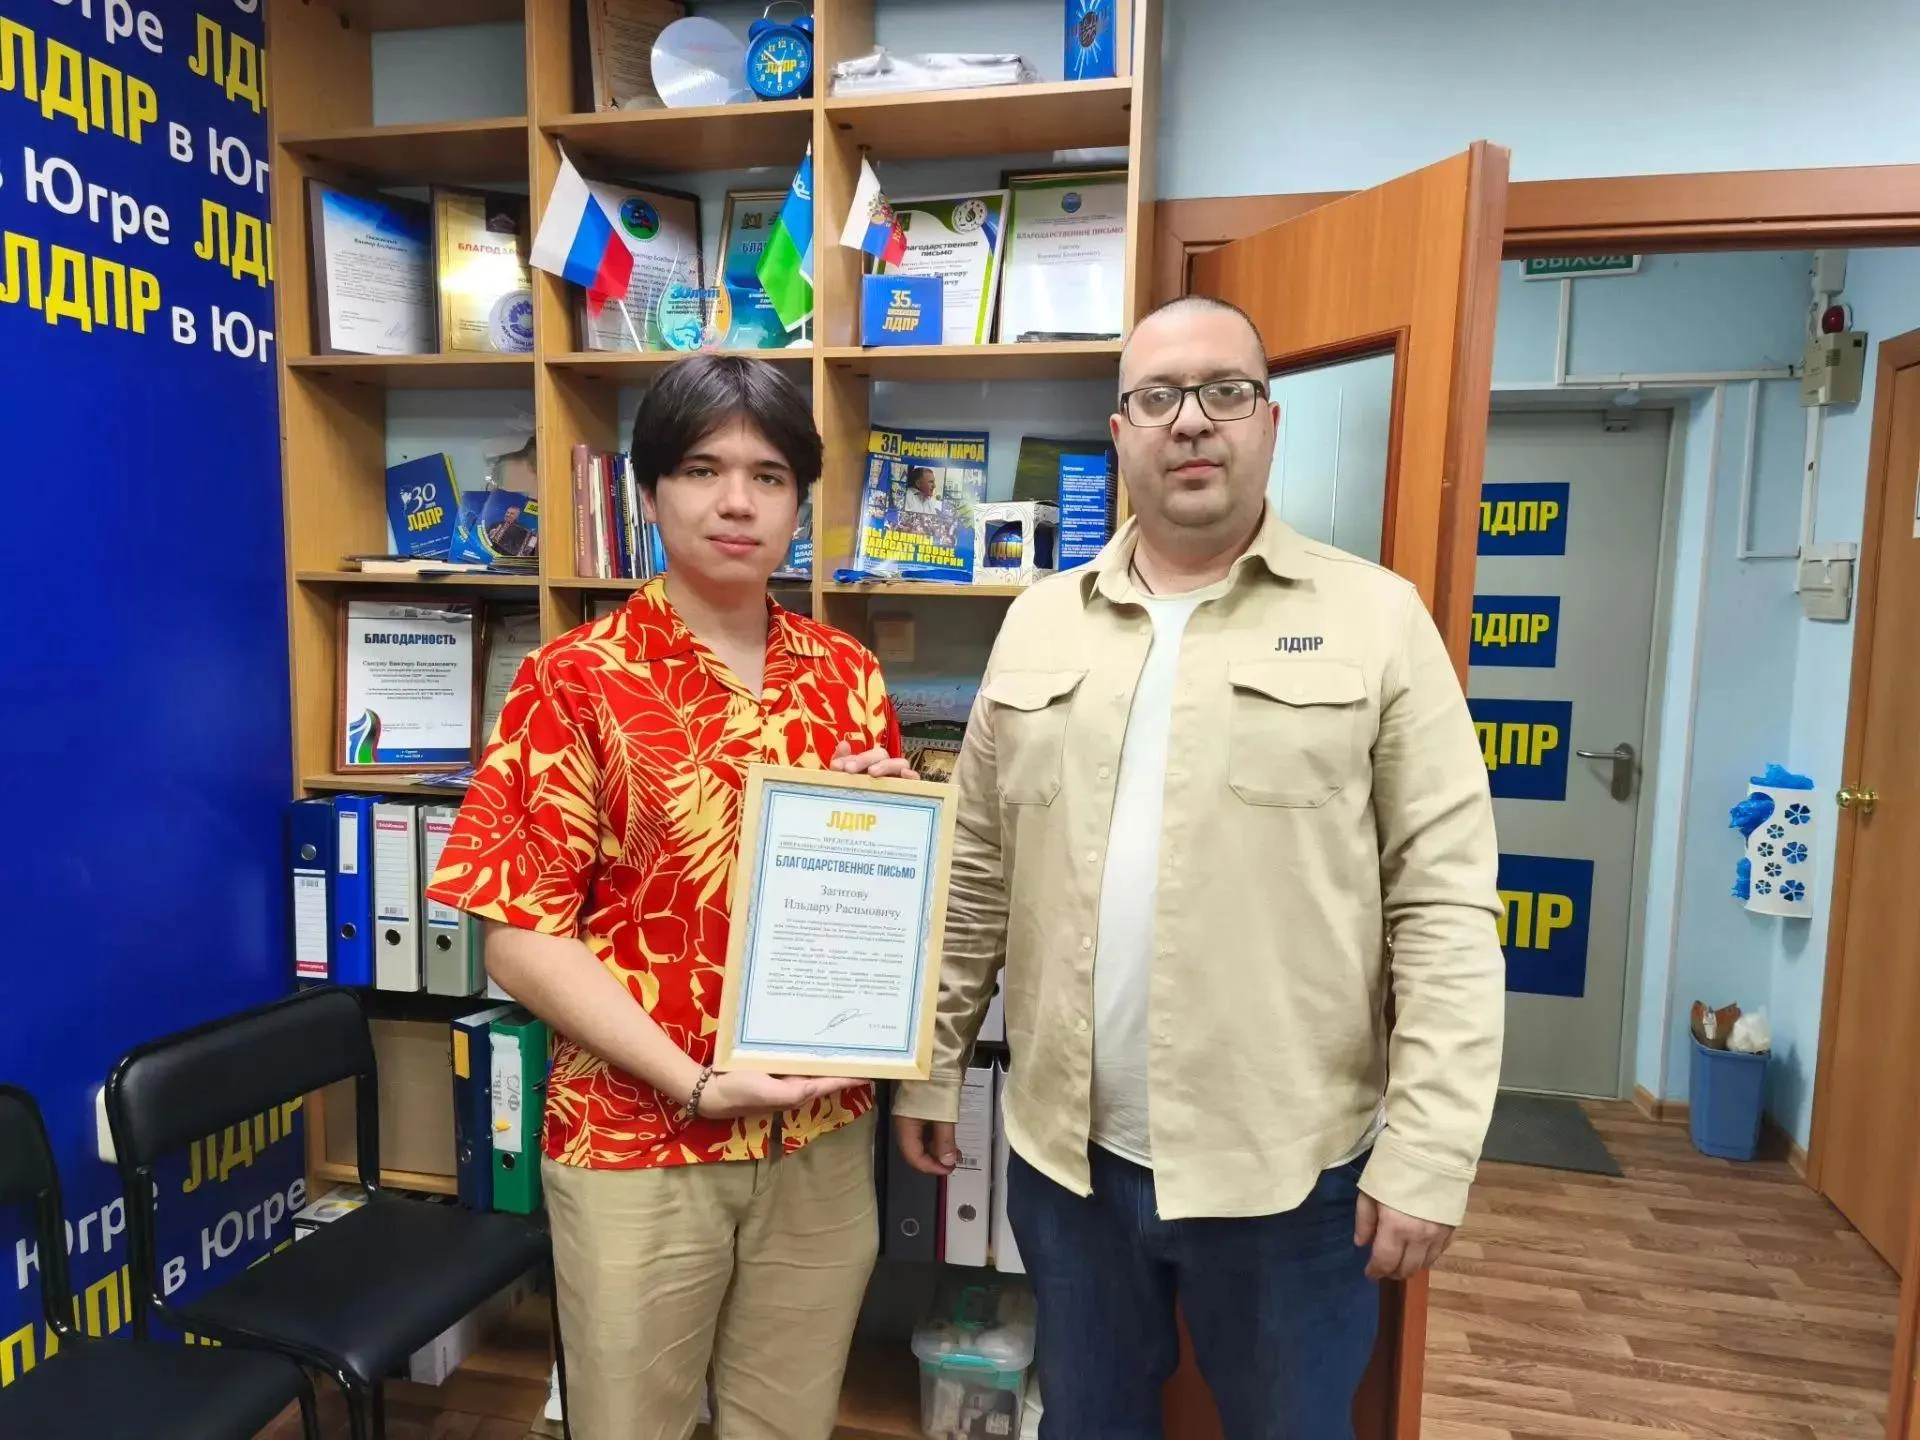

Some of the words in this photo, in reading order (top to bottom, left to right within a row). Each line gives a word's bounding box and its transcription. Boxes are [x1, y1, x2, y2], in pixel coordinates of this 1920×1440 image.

[54, 0, 164, 54] ре
[188, 13, 267, 115] ЛД
[0, 16, 158, 144] ЛДПР
[168, 121, 194, 163] в
[208, 127, 269, 194] Юг
[23, 146, 170, 245] Югре
[193, 198, 274, 288] ЛД
[457, 242, 522, 256] БЛАГОДАР
[0, 230, 161, 335] ЛДПР
[890, 289, 912, 308] 35
[171, 305, 198, 345] в
[211, 304, 274, 364] Юг
[882, 316, 919, 333] ЛДПР
[881, 433, 899, 453] ЗА
[901, 440, 949, 459] РУССКИЙ
[950, 442, 986, 463] НАРОД
[411, 483, 436, 515] 30
[407, 506, 444, 532] ЛДПР
[862, 536, 916, 553] АПИСАТЬ
[863, 527, 882, 539] Ы
[795, 549, 813, 558] ВЛАД
[796, 543, 813, 551] ГОВО
[861, 546, 914, 562] ЧЕБНИКИ
[917, 552, 965, 568] ИСТОРИИ
[364, 633, 457, 646] БЛАГОДАРНОСТЬ
[1274, 636, 1324, 653] ЛДПР
[826, 810, 877, 832] ЛДПР
[775, 854, 875, 876] БЛАГОДАРСТВЕННОЕ
[876, 864, 916, 880] ПИСЬМО
[820, 884, 870, 900] Загитову
[784, 898, 832, 915] Ильдару
[835, 902, 901, 919] Расимовичу
[15, 1181, 159, 1290] Югр
[163, 1255, 188, 1297] в
[201, 1177, 307, 1271] Югре
